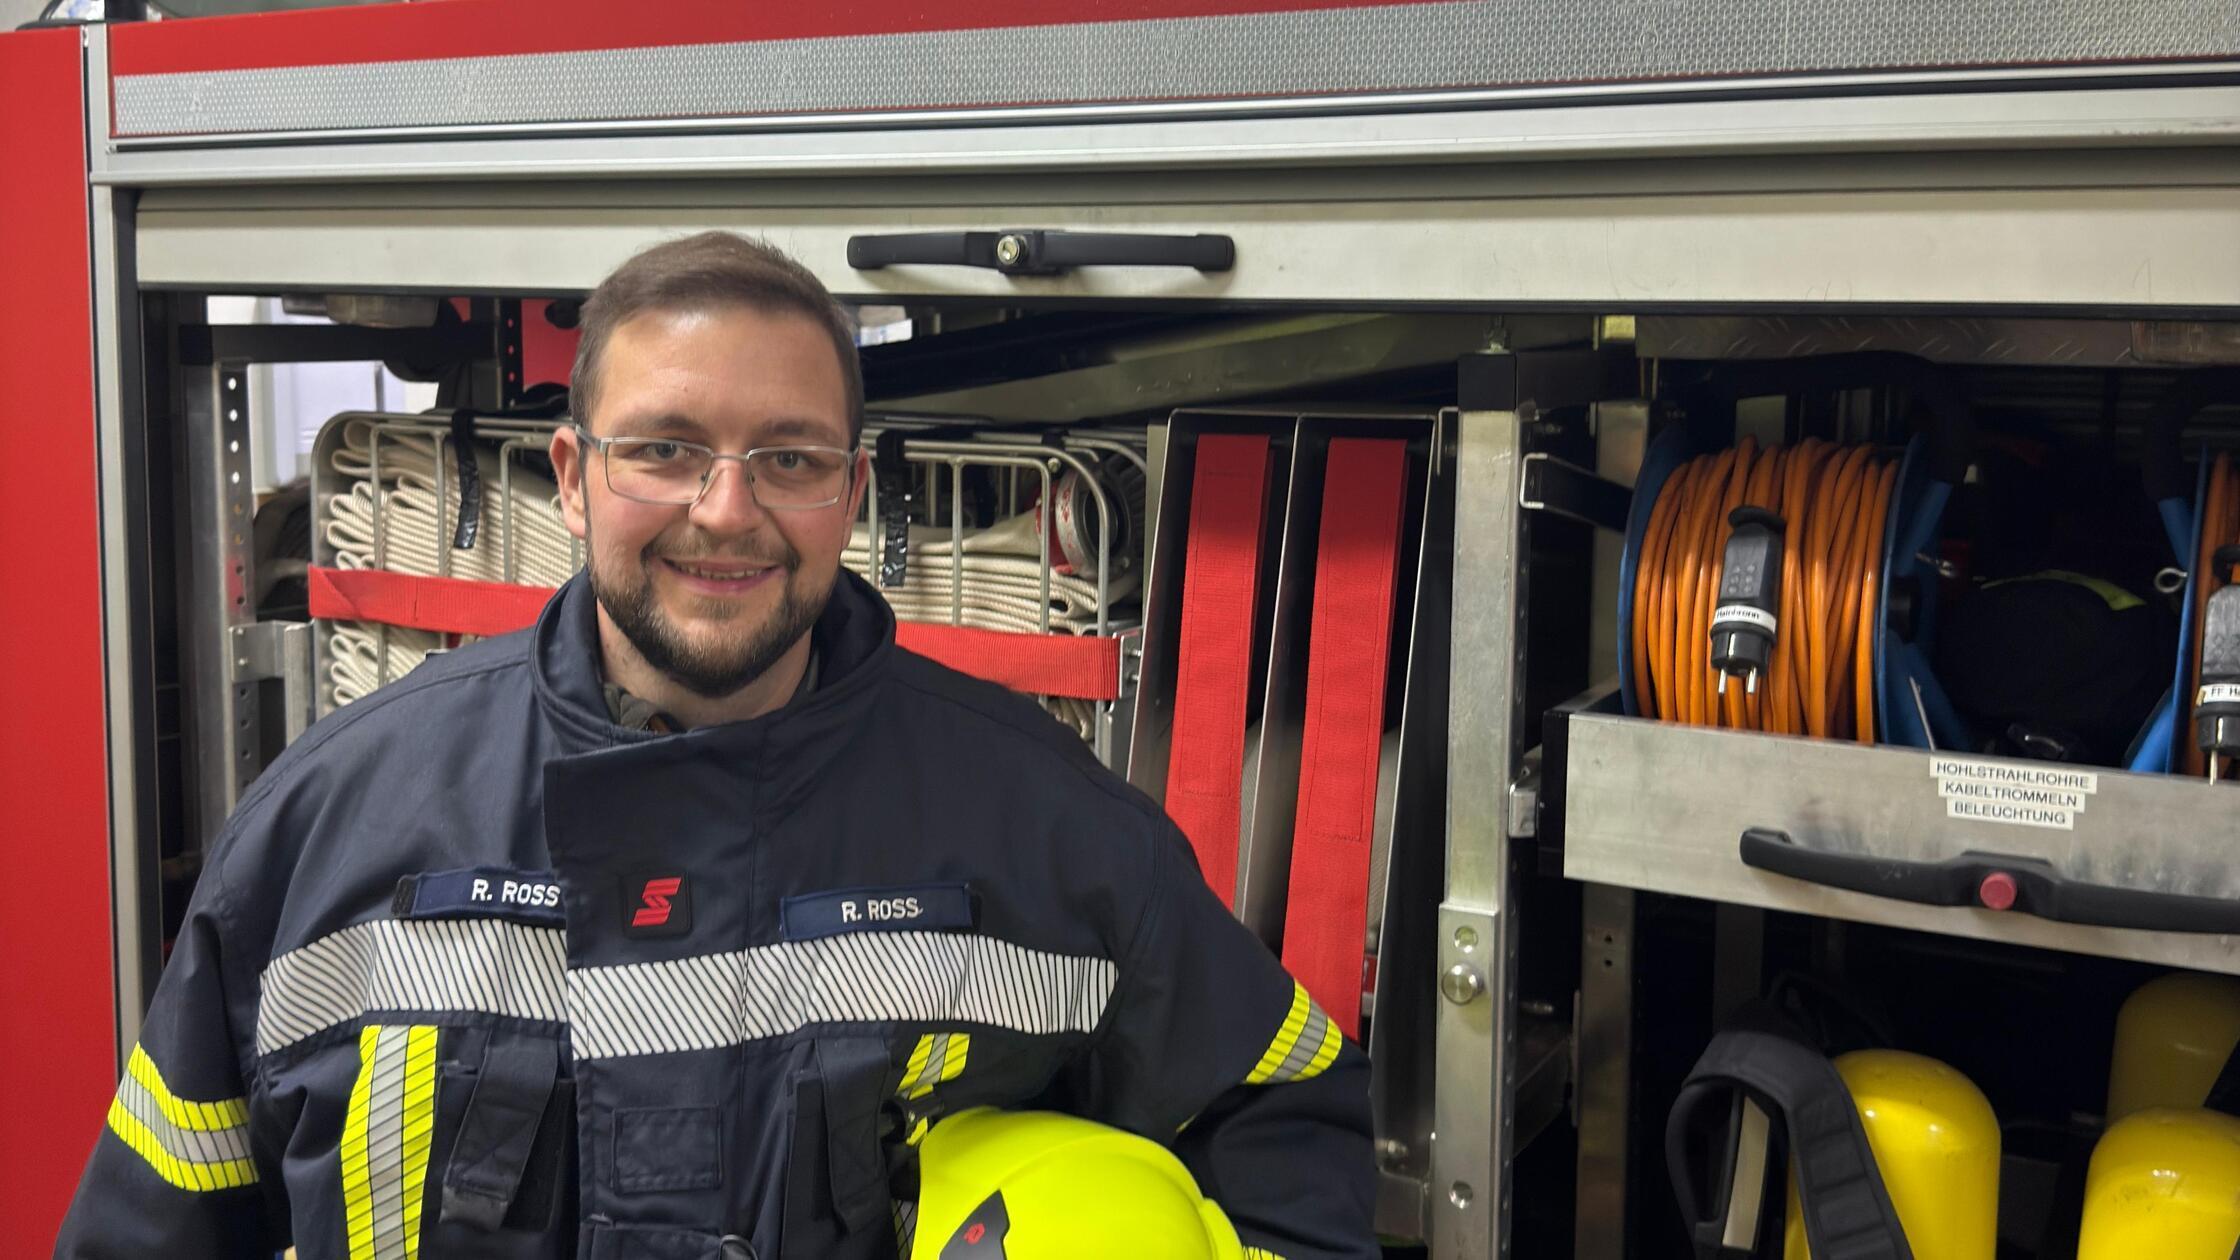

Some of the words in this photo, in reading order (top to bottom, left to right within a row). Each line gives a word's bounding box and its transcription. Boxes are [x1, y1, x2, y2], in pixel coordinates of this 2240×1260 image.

[1936, 761, 2090, 788] HOHLSTRAHLROHRE
[1944, 782, 2077, 807] KABELTROMMELN
[1954, 801, 2066, 825] BELEUCHTUNG
[471, 878, 493, 901] R.
[501, 880, 561, 907] ROSS
[841, 900, 863, 923] R.
[867, 896, 920, 921] ROSS
